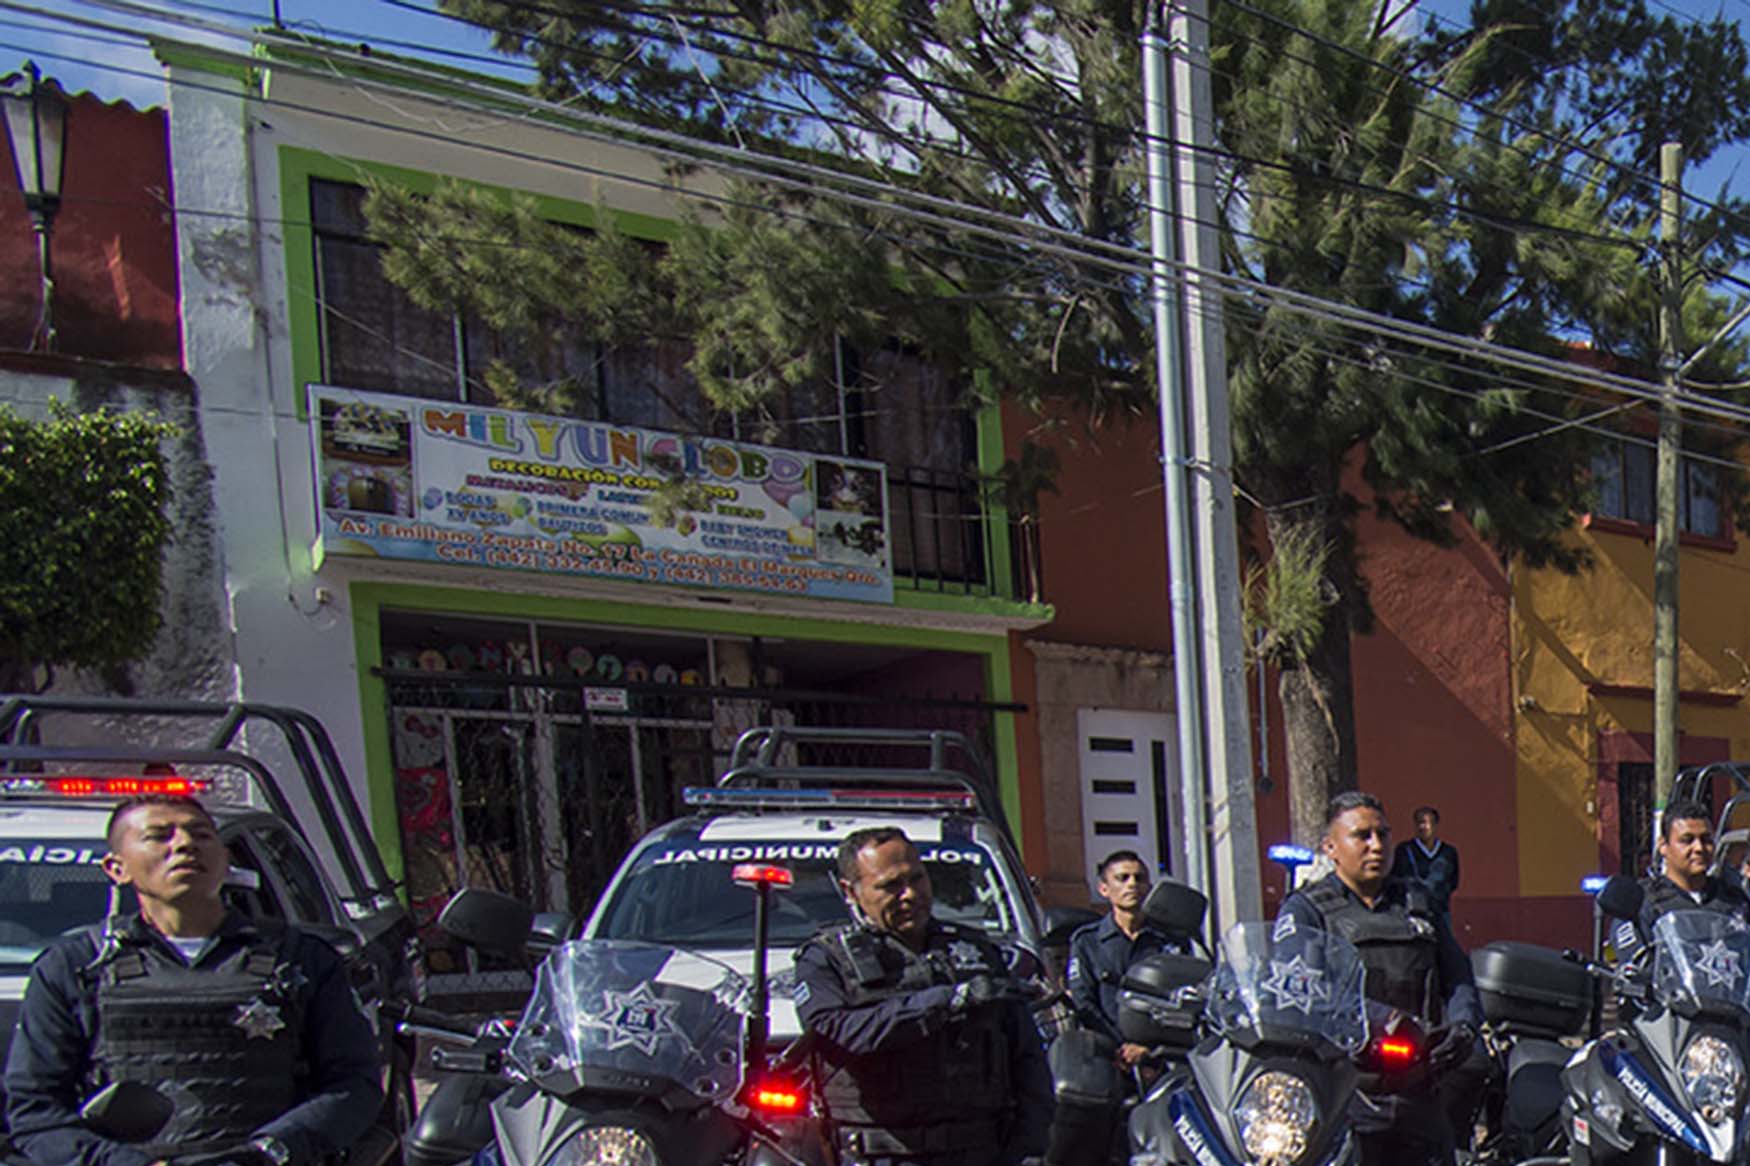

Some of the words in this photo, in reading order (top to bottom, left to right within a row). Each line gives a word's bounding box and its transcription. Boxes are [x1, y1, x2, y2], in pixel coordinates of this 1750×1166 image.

[424, 409, 519, 449] MIL
[527, 417, 640, 467] YUN
[379, 522, 476, 544] Emiliano
